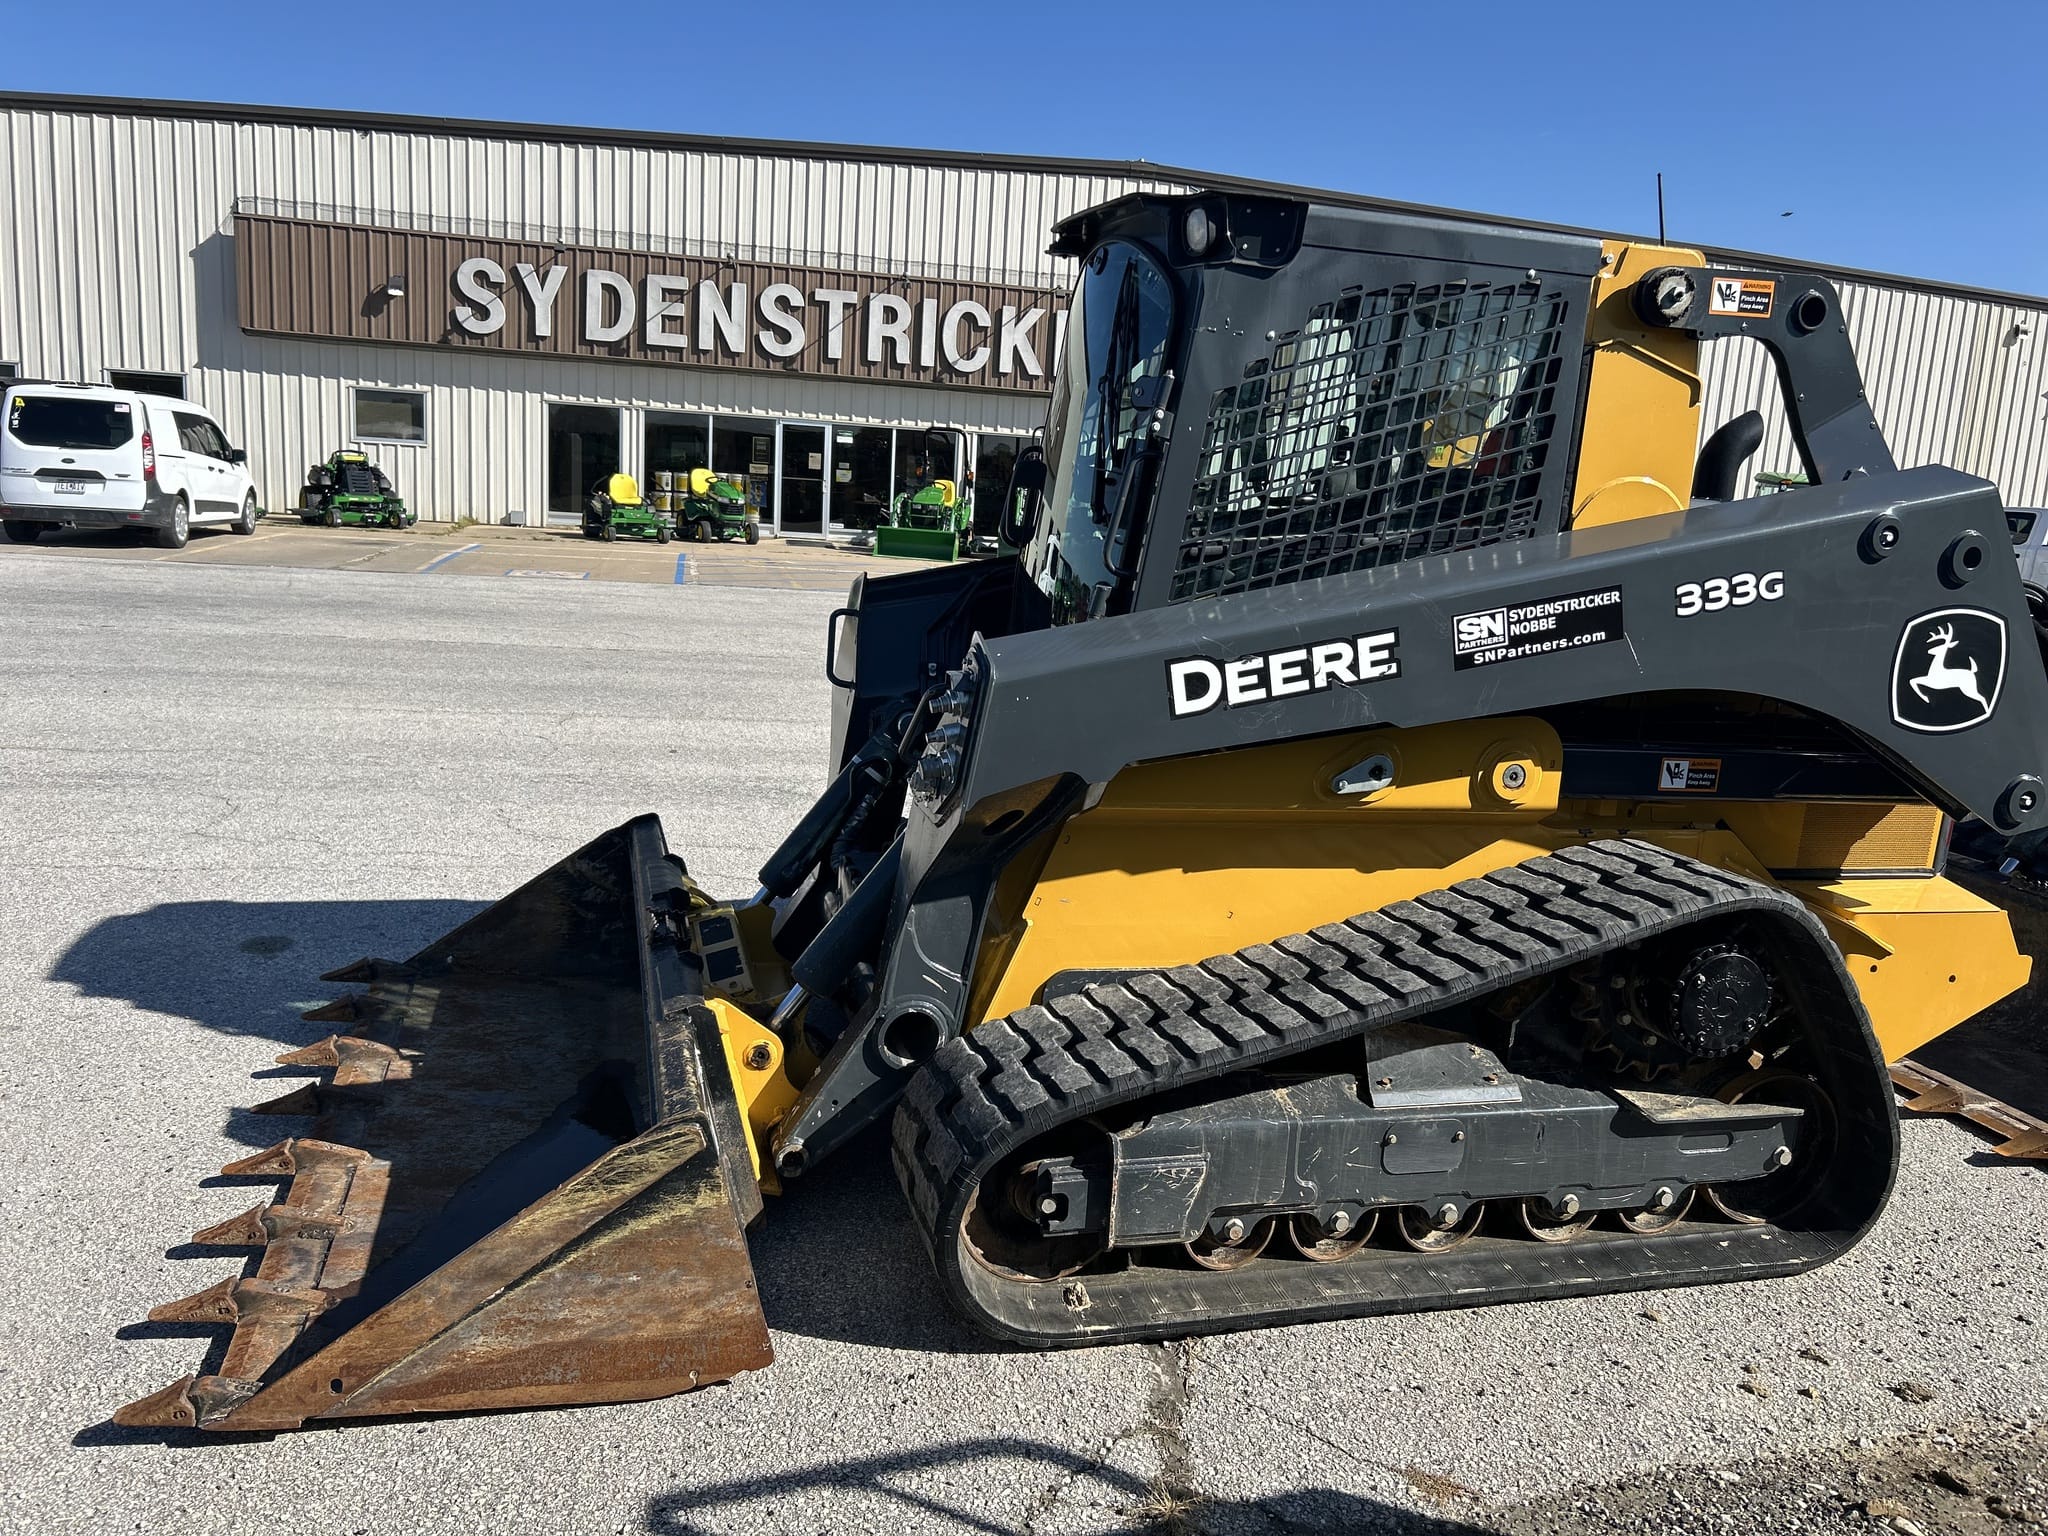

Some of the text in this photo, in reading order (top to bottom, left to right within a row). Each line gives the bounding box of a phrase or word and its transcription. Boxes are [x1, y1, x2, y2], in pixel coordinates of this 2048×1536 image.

[455, 257, 1068, 377] SYDENSTRICK
[1752, 303, 1764, 311] Away
[1509, 591, 1621, 622] SYDENSTRICKER
[1676, 571, 1784, 616] 333G
[1458, 613, 1504, 642] SN
[1459, 635, 1505, 650] PARTNERS
[1510, 617, 1557, 637] NOBBE
[1473, 630, 1606, 664] SNPartners.com
[1170, 632, 1398, 716] DEERE
